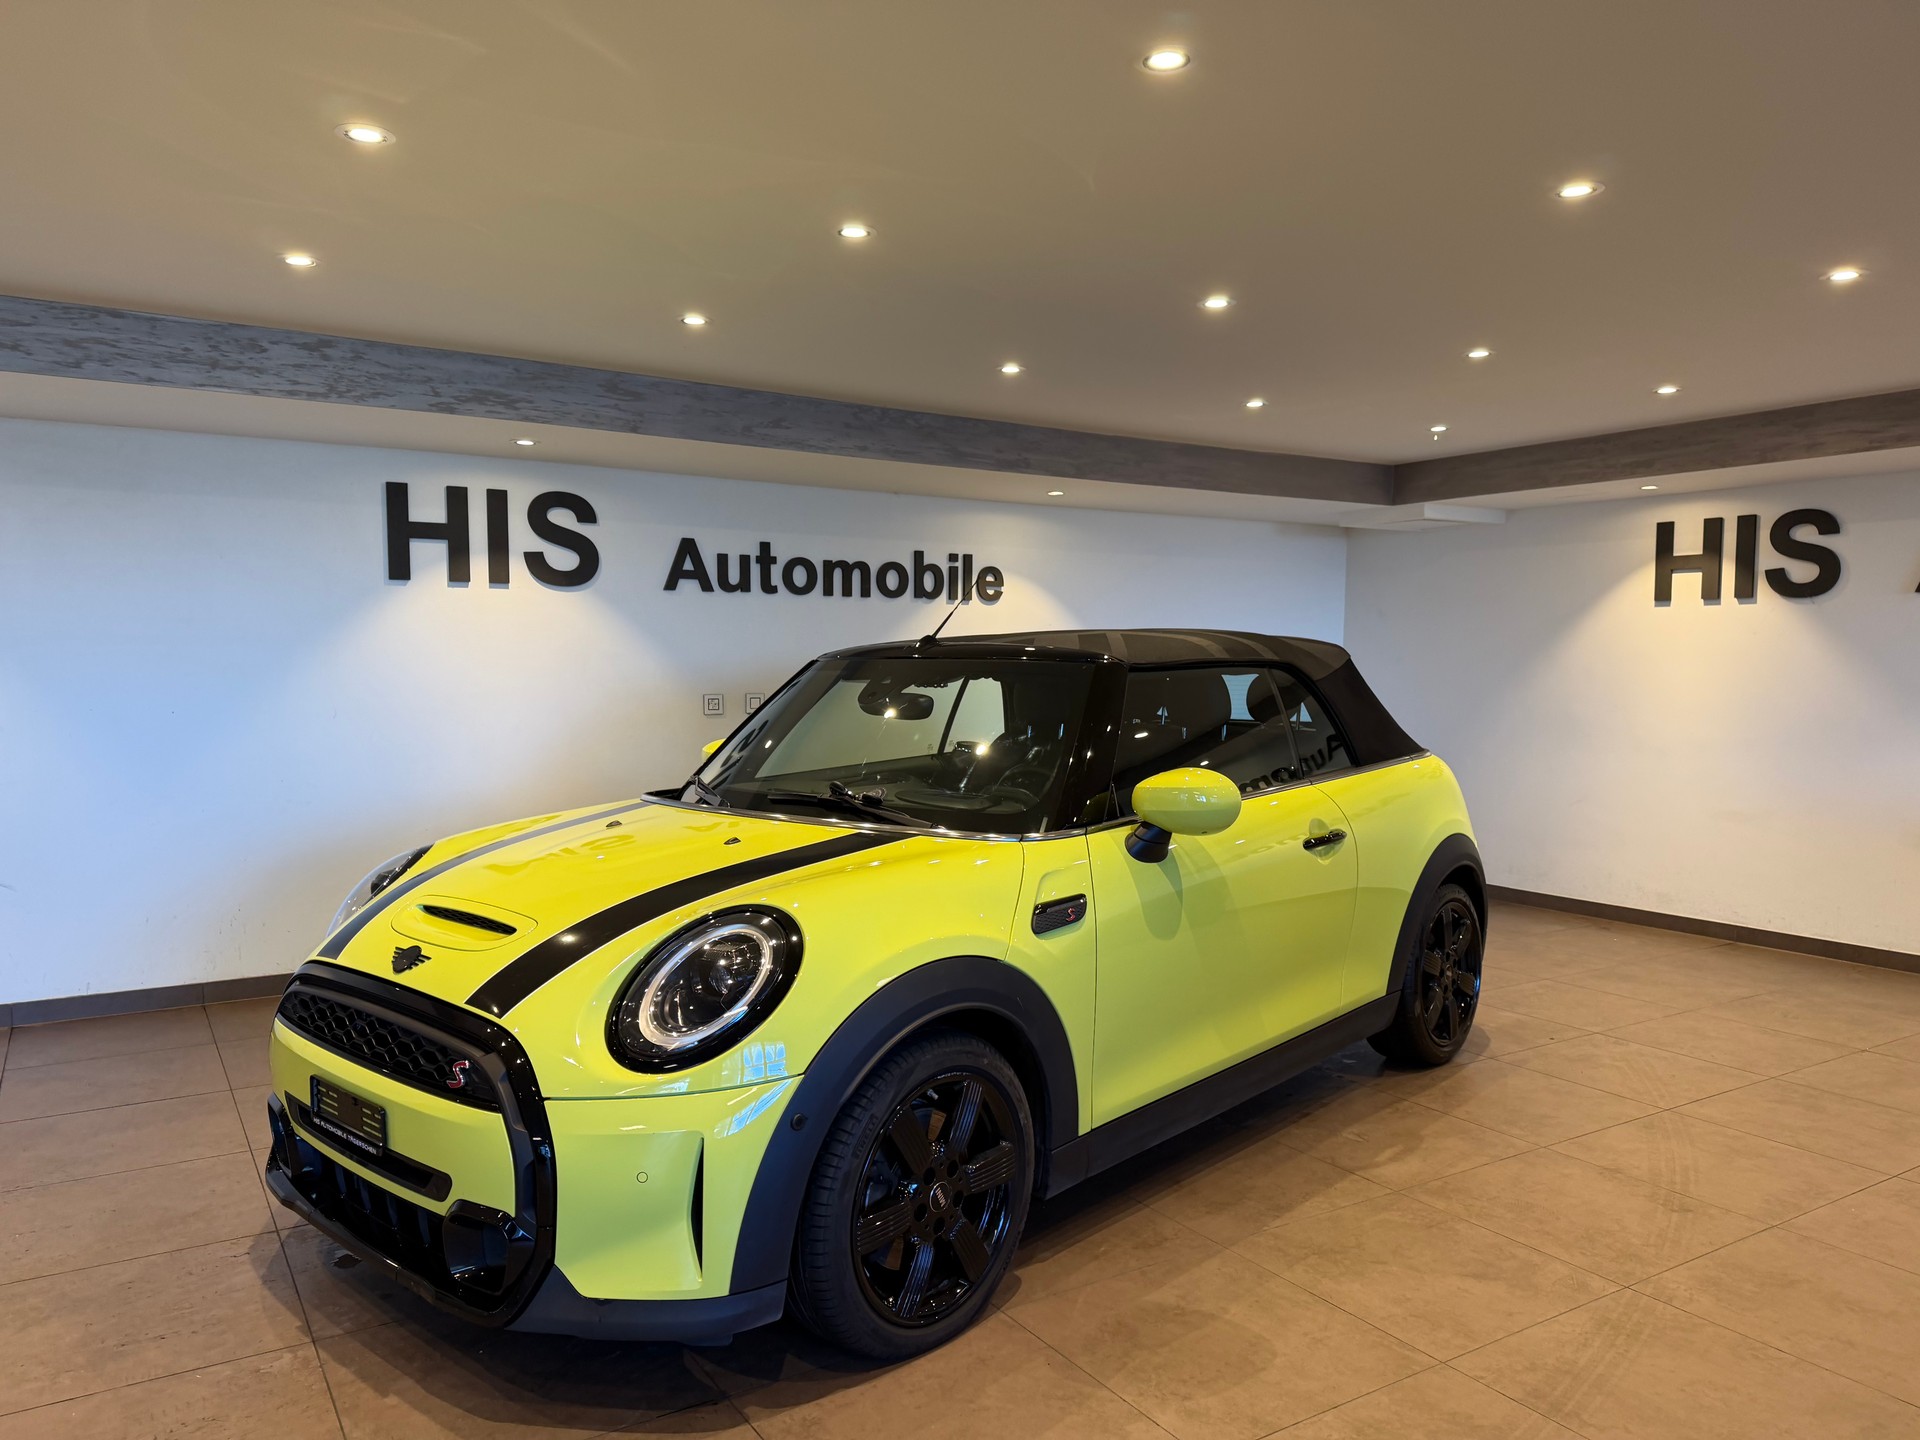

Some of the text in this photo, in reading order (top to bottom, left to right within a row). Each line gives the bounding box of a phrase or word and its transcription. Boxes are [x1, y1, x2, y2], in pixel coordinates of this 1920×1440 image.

[384, 481, 1005, 602] HIS Automobile
[1654, 508, 1842, 602] HIS
[1066, 907, 1075, 921] S
[446, 1059, 469, 1089] S
